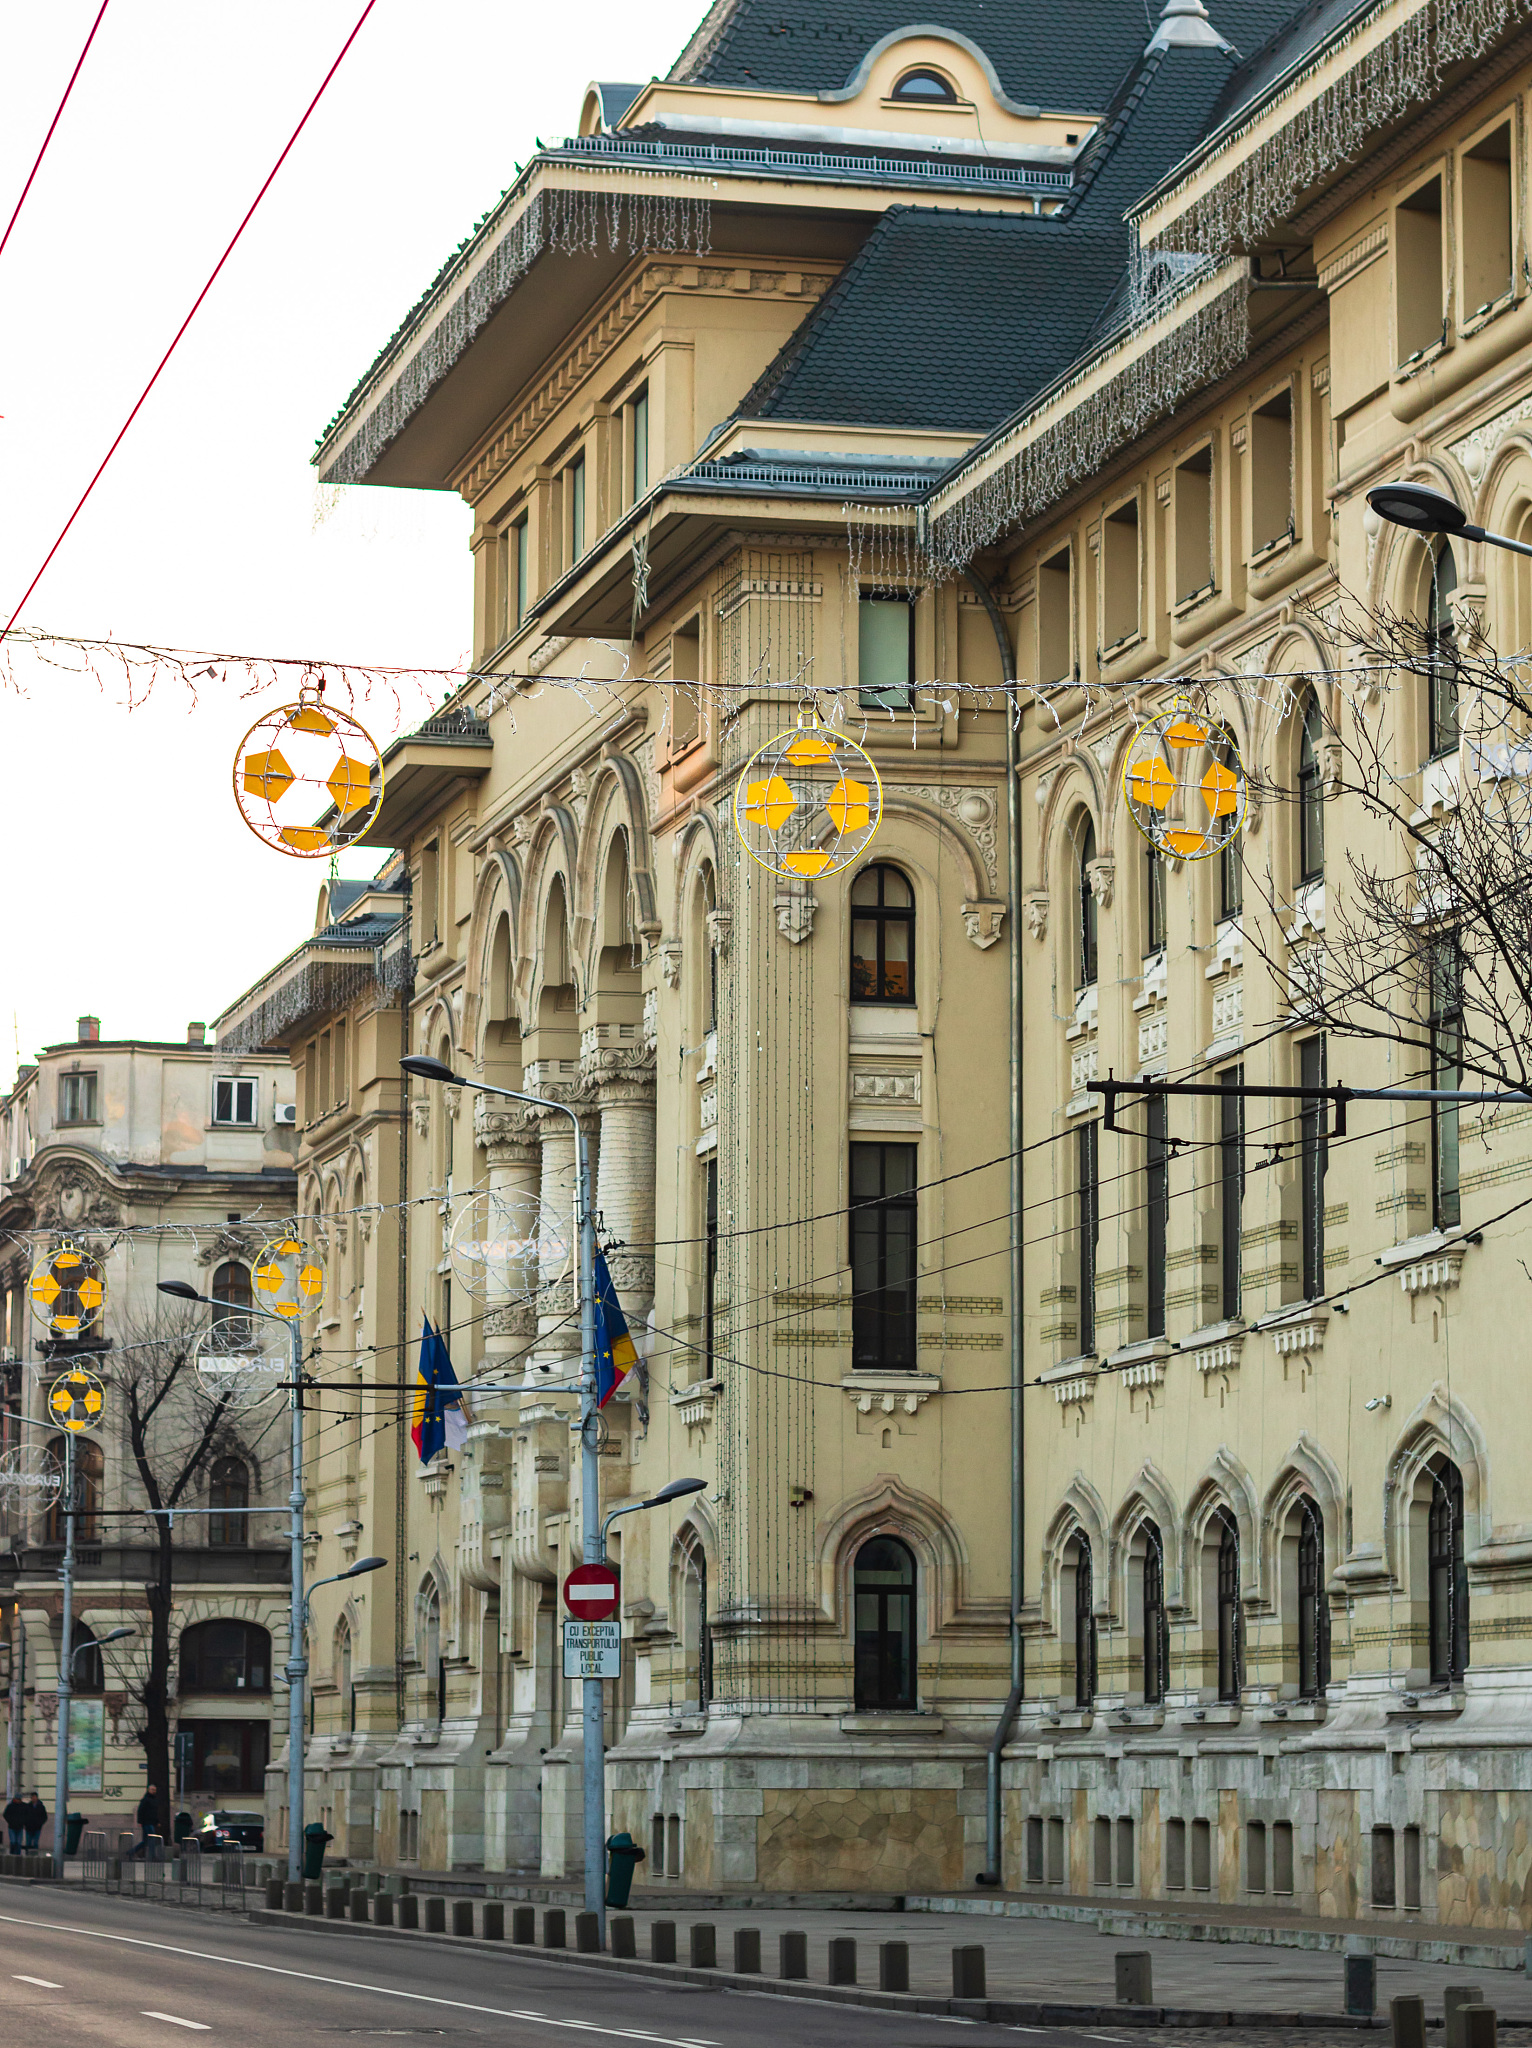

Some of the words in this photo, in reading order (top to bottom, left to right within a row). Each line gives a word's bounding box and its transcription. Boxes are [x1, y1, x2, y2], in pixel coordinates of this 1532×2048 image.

[569, 1625, 579, 1637] CU
[582, 1625, 615, 1637] EXCEPTIA
[566, 1638, 619, 1649] TRANSPORTULUI
[579, 1650, 604, 1662] PUBLIC
[580, 1663, 603, 1674] LOCAL
